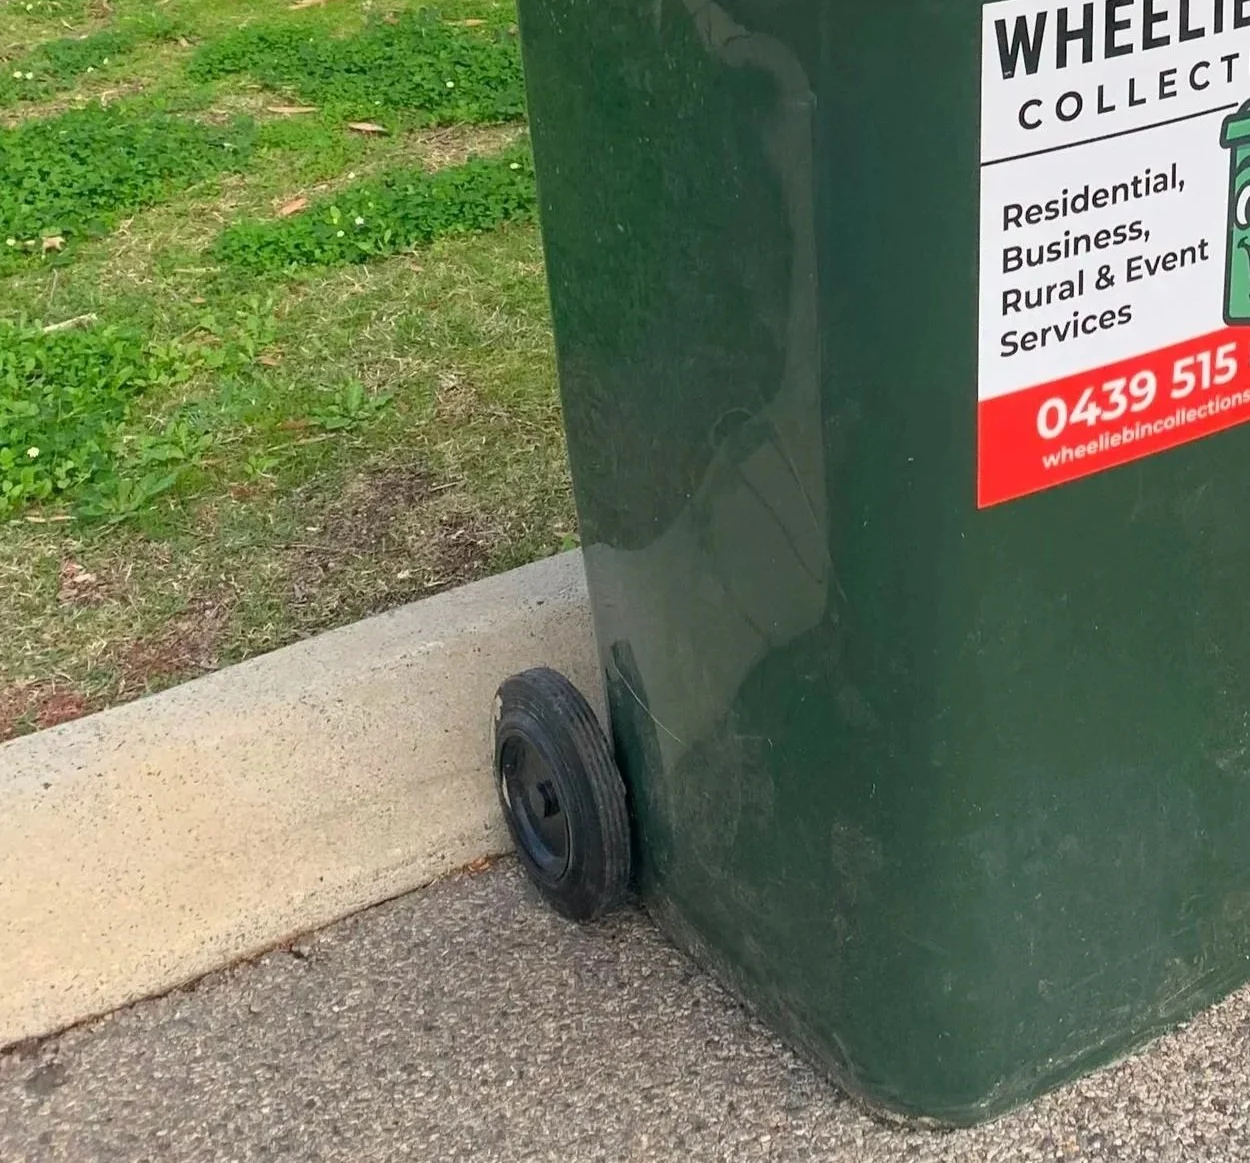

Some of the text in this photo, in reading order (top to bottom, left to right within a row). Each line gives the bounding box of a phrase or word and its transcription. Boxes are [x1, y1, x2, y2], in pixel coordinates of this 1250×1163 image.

[1002, 163, 1185, 231] Residential,
[1001, 238, 1209, 315] Rural & Event
[1002, 219, 1150, 273] Business,
[1000, 304, 1132, 357] Services
[1036, 370, 1157, 439] 0439
[1170, 342, 1238, 399] 515
